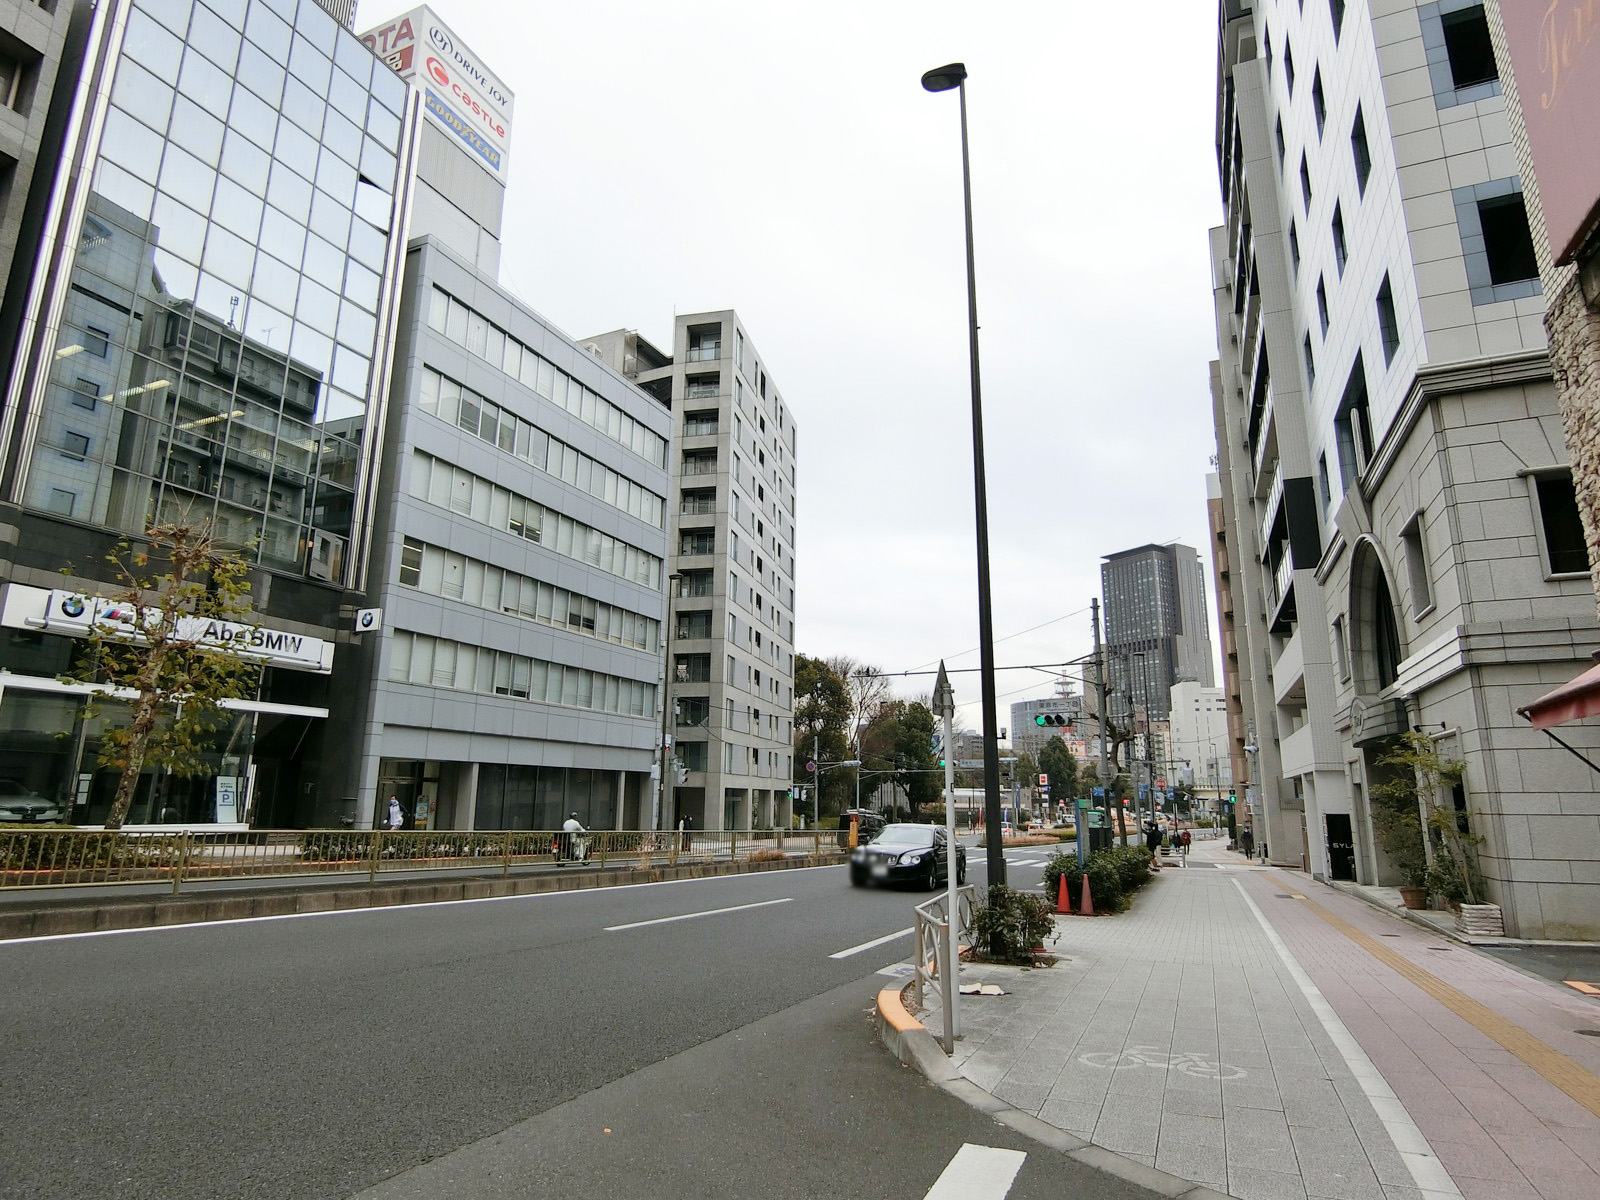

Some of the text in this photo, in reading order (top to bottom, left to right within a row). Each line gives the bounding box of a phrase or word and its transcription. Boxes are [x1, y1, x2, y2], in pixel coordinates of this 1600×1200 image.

[454, 51, 508, 107] DRIVE JOY
[426, 95, 499, 165] GOODYEAR
[251, 630, 303, 654] BMW
[222, 794, 229, 803] P
